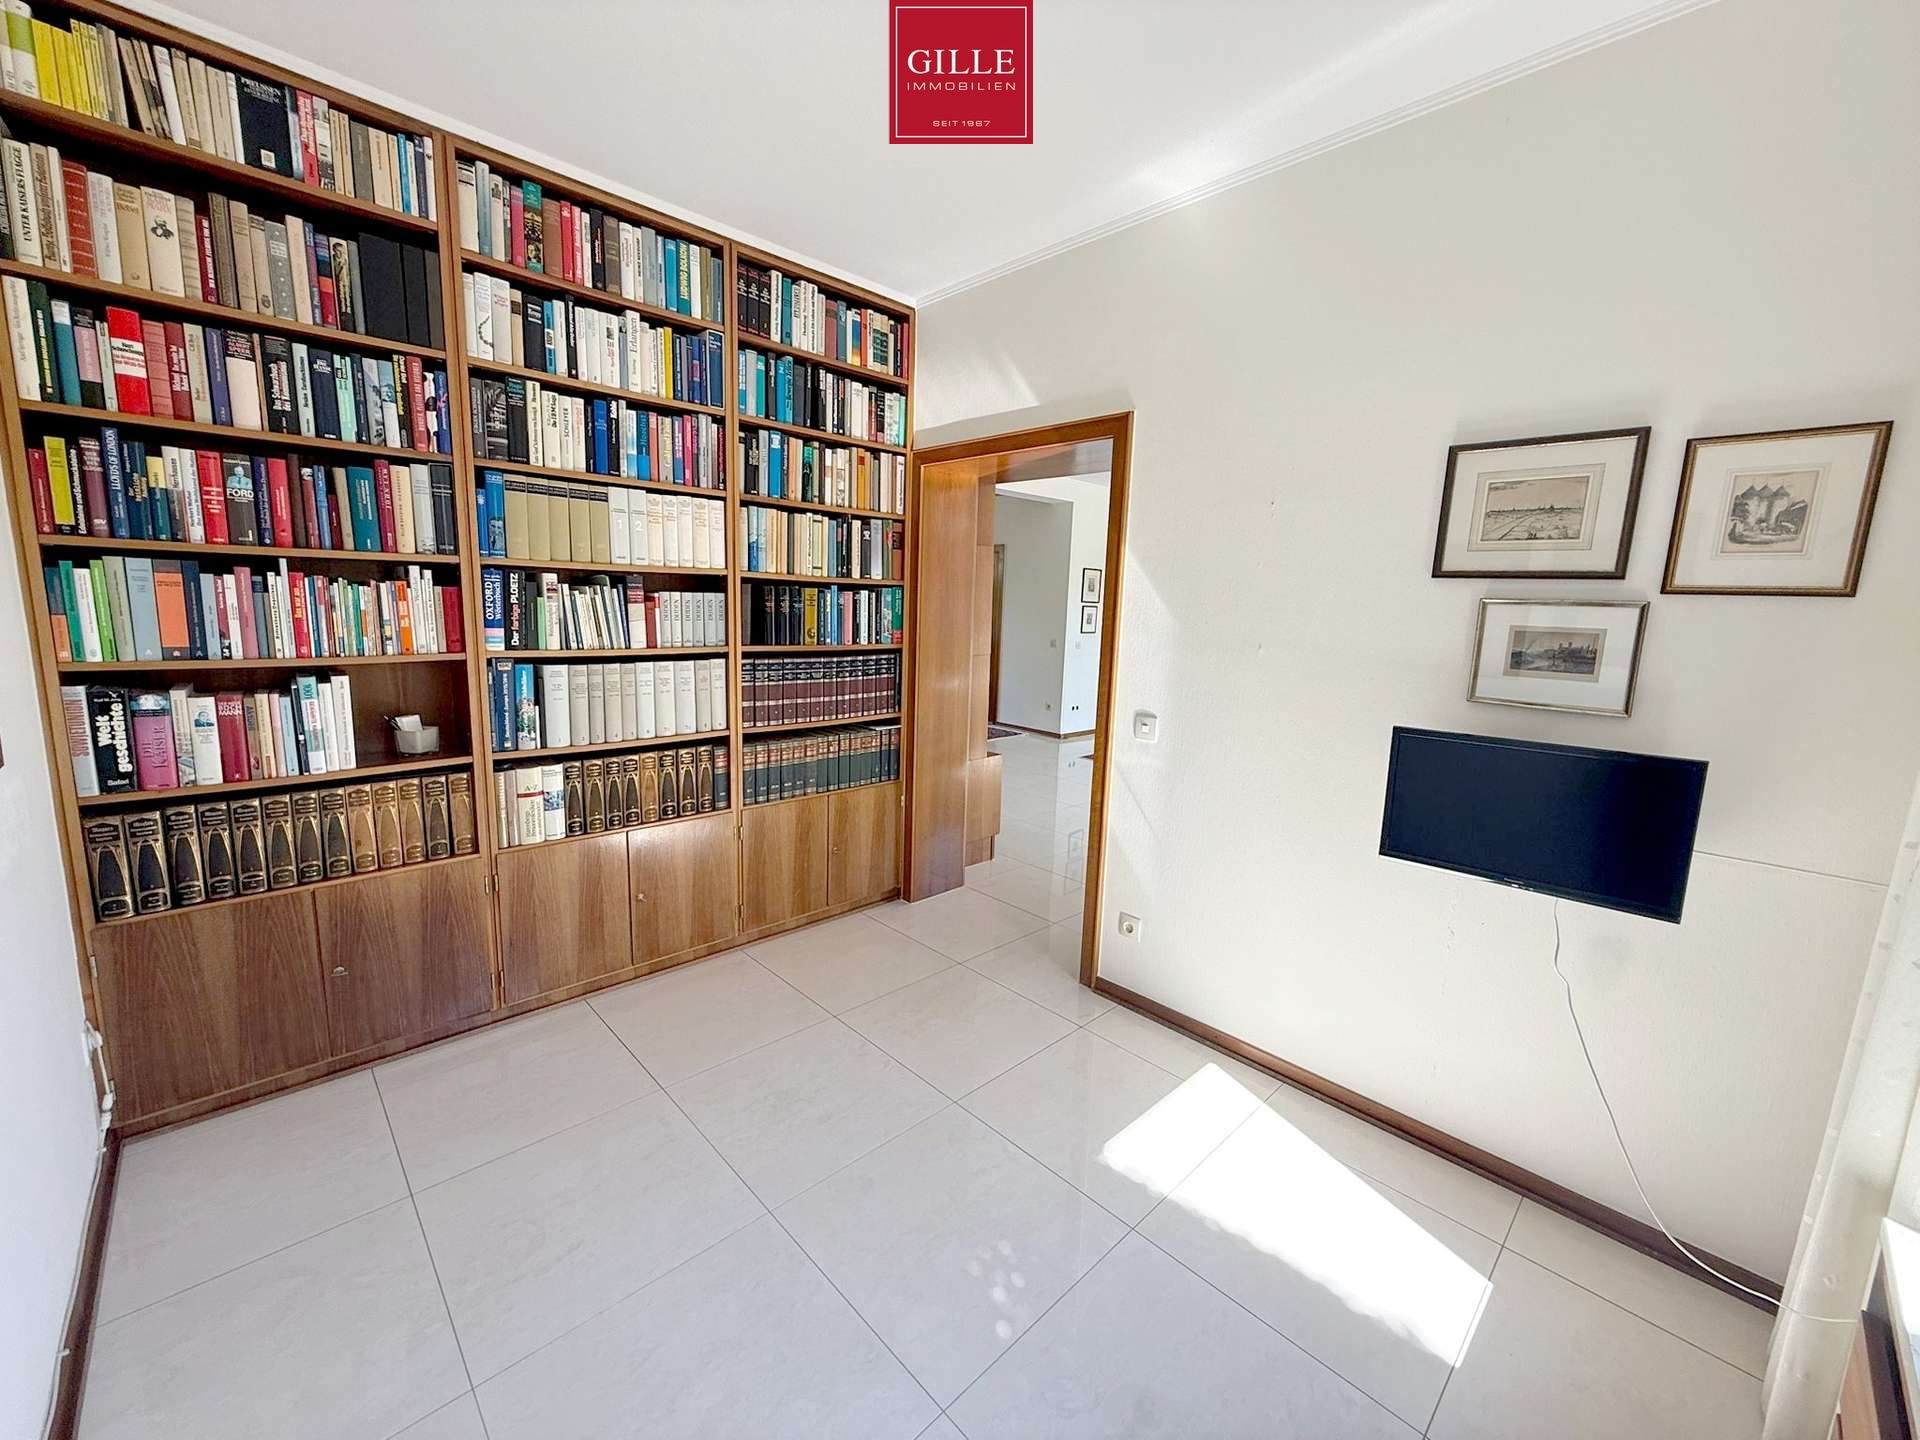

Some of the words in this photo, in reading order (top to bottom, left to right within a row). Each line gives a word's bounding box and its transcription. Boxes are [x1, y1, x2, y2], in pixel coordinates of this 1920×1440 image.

[12, 147, 24, 177] FLAGGE
[17, 178, 28, 213] KAISERS
[20, 214, 32, 242] UNTER
[629, 317, 639, 353] Erlangen
[268, 363, 280, 398] Schwarzbuch
[105, 429, 117, 455] LONDON
[170, 458, 180, 489] Herrhausen
[227, 489, 254, 497] FORD
[635, 521, 643, 530] 2
[484, 582, 494, 620] OXFORD
[494, 582, 502, 620] Wörterbuch
[510, 572, 519, 603] PLOETZ
[511, 604, 521, 630] farbige
[511, 631, 519, 645] Der
[302, 683, 314, 699] 1001
[64, 699, 89, 756] SOWJETUNION
[94, 715, 112, 746] Welt
[109, 702, 133, 772] geschichte
[152, 726, 168, 768] KAISER
